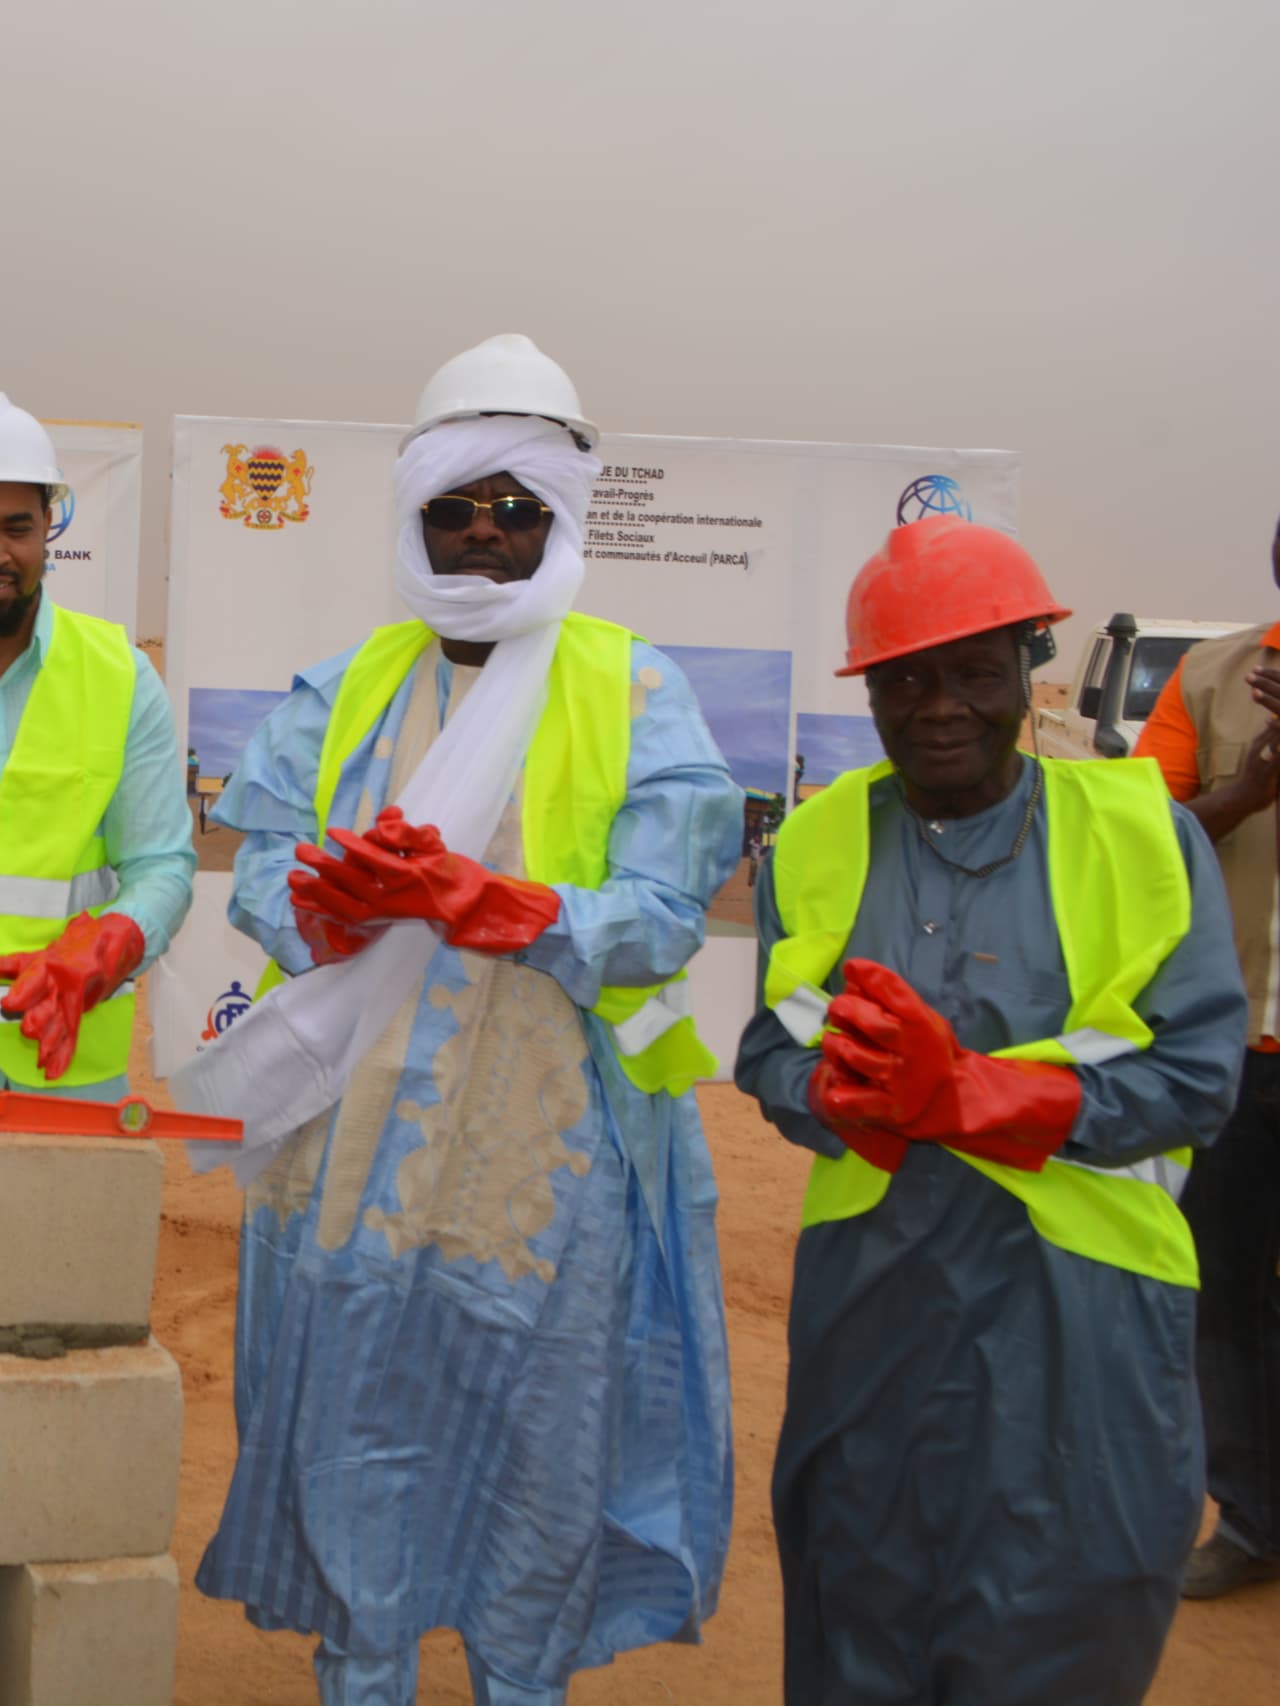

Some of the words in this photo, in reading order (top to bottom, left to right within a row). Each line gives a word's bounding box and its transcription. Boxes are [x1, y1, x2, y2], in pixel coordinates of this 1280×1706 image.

[615, 466, 629, 478] DU
[632, 467, 665, 479] TCHAD
[600, 510, 610, 520] et
[613, 510, 625, 521] de
[627, 510, 636, 521] la
[638, 513, 694, 525] coopération
[696, 514, 763, 528] internationale
[588, 529, 614, 541] Filets
[617, 530, 655, 543] Sociaux
[55, 550, 92, 560] BANK
[595, 550, 661, 561] communautés
[664, 552, 707, 563] d'Acceuil
